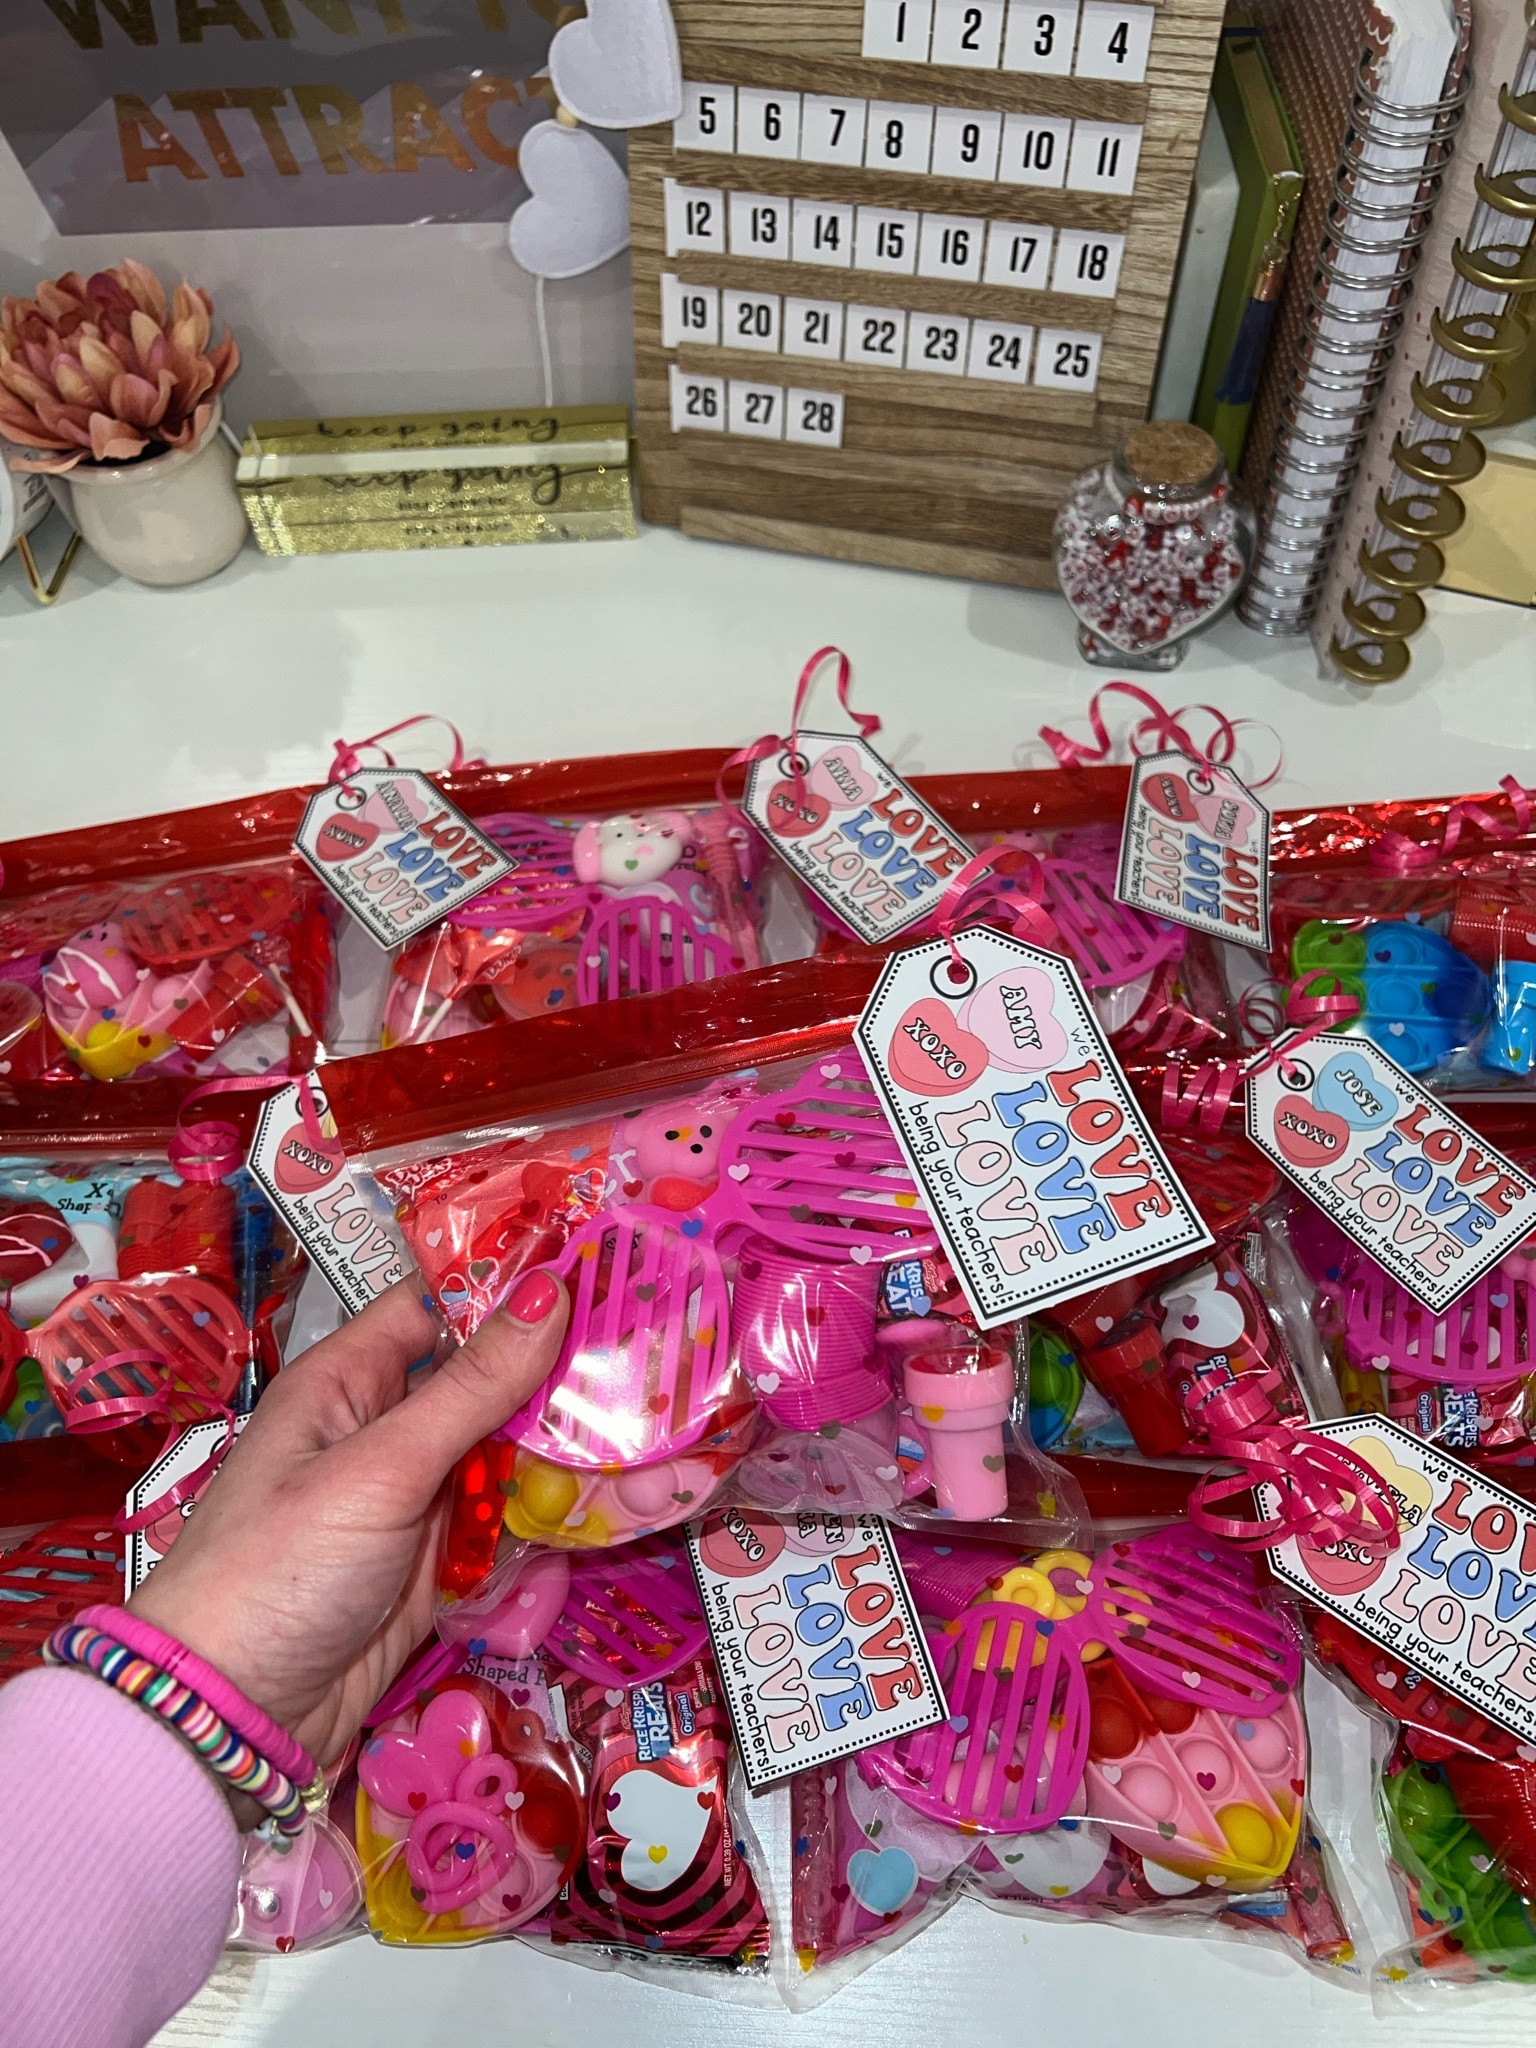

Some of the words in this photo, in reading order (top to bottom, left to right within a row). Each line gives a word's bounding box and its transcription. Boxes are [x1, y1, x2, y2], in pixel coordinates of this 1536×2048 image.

[896, 3, 906, 43] 1
[961, 8, 983, 50] 2
[1034, 15, 1056, 56] 3
[1108, 22, 1129, 64] 4
[700, 97, 717, 135] 5
[764, 103, 781, 141] 6
[830, 109, 846, 147] 7
[885, 120, 903, 159] 8
[962, 124, 980, 163] 9
[1023, 130, 1055, 170] 10
[1097, 138, 1120, 177] 11
[685, 201, 713, 237] 12
[752, 208, 777, 243] 13
[814, 215, 840, 251] 14
[877, 222, 905, 259] 15
[940, 230, 970, 266] 16
[1009, 236, 1038, 273] 17
[1077, 244, 1110, 281] 18
[682, 295, 708, 329] 19
[738, 303, 772, 337] 20
[804, 311, 829, 345] 21
[862, 319, 897, 354] 22
[924, 327, 959, 362] 23
[987, 334, 1022, 370] 24
[1053, 342, 1089, 378] 25
[685, 385, 718, 418] 26
[744, 392, 775, 425] 27
[802, 400, 835, 433] 28
[771, 793, 820, 824] XOXO
[823, 757, 864, 802] ARIA
[876, 772, 892, 789] we
[416, 811, 498, 881] LOVE
[870, 789, 966, 879] LOVE
[1132, 804, 1152, 830] being
[1133, 832, 1146, 855] your
[332, 864, 356, 896] being
[350, 883, 371, 904] your
[349, 851, 430, 925] LOVE
[383, 831, 466, 903] LOVE
[789, 841, 816, 876] being
[815, 868, 838, 891] your
[809, 832, 906, 922] LOVE
[840, 809, 937, 901] LOVE
[1143, 818, 1182, 906] LOVE
[1183, 833, 1221, 920] LOVE
[1222, 847, 1260, 932] LOVE
[903, 1017, 967, 1083] XOXO
[1000, 986, 1042, 1049] AMY
[1071, 1027, 1091, 1056] we
[1334, 1069, 1383, 1117] JOSE
[1395, 1082, 1415, 1104] we
[283, 1140, 334, 1176] XOXO
[909, 1101, 939, 1155] being
[929, 1157, 963, 1202] your
[1047, 1058, 1172, 1230] LOVE
[1278, 1112, 1337, 1150] XOXO
[1394, 1104, 1526, 1218] LOVE
[935, 1100, 1058, 1275] LOVE
[992, 1080, 1116, 1254] LOVE
[1364, 1131, 1496, 1247] LOVE
[56, 1198, 111, 1214] Shap
[293, 1195, 320, 1232] being
[313, 1230, 340, 1258] your
[1309, 1169, 1345, 1207] being
[1341, 1207, 1378, 1237] your
[1332, 1158, 1464, 1277] LOVE
[314, 1183, 404, 1295] LOVE
[1423, 1461, 1449, 1482] we
[857, 1513, 874, 1542] we
[1408, 1524, 1536, 1643] LOV
[711, 1582, 735, 1633] being
[724, 1637, 747, 1679] your
[783, 1563, 872, 1732] LOVE
[832, 1543, 924, 1712] LOVE
[1354, 1594, 1402, 1637] being
[1406, 1632, 1448, 1665] your
[1452, 1660, 1536, 1722] teachers
[1380, 1569, 1536, 1702] LOVE
[462, 1658, 528, 1684] Shaped
[733, 1583, 820, 1754] LOVE
[638, 1729, 653, 1761] RICE
[677, 1695, 693, 1733] Original
[724, 1874, 732, 1887] NET
